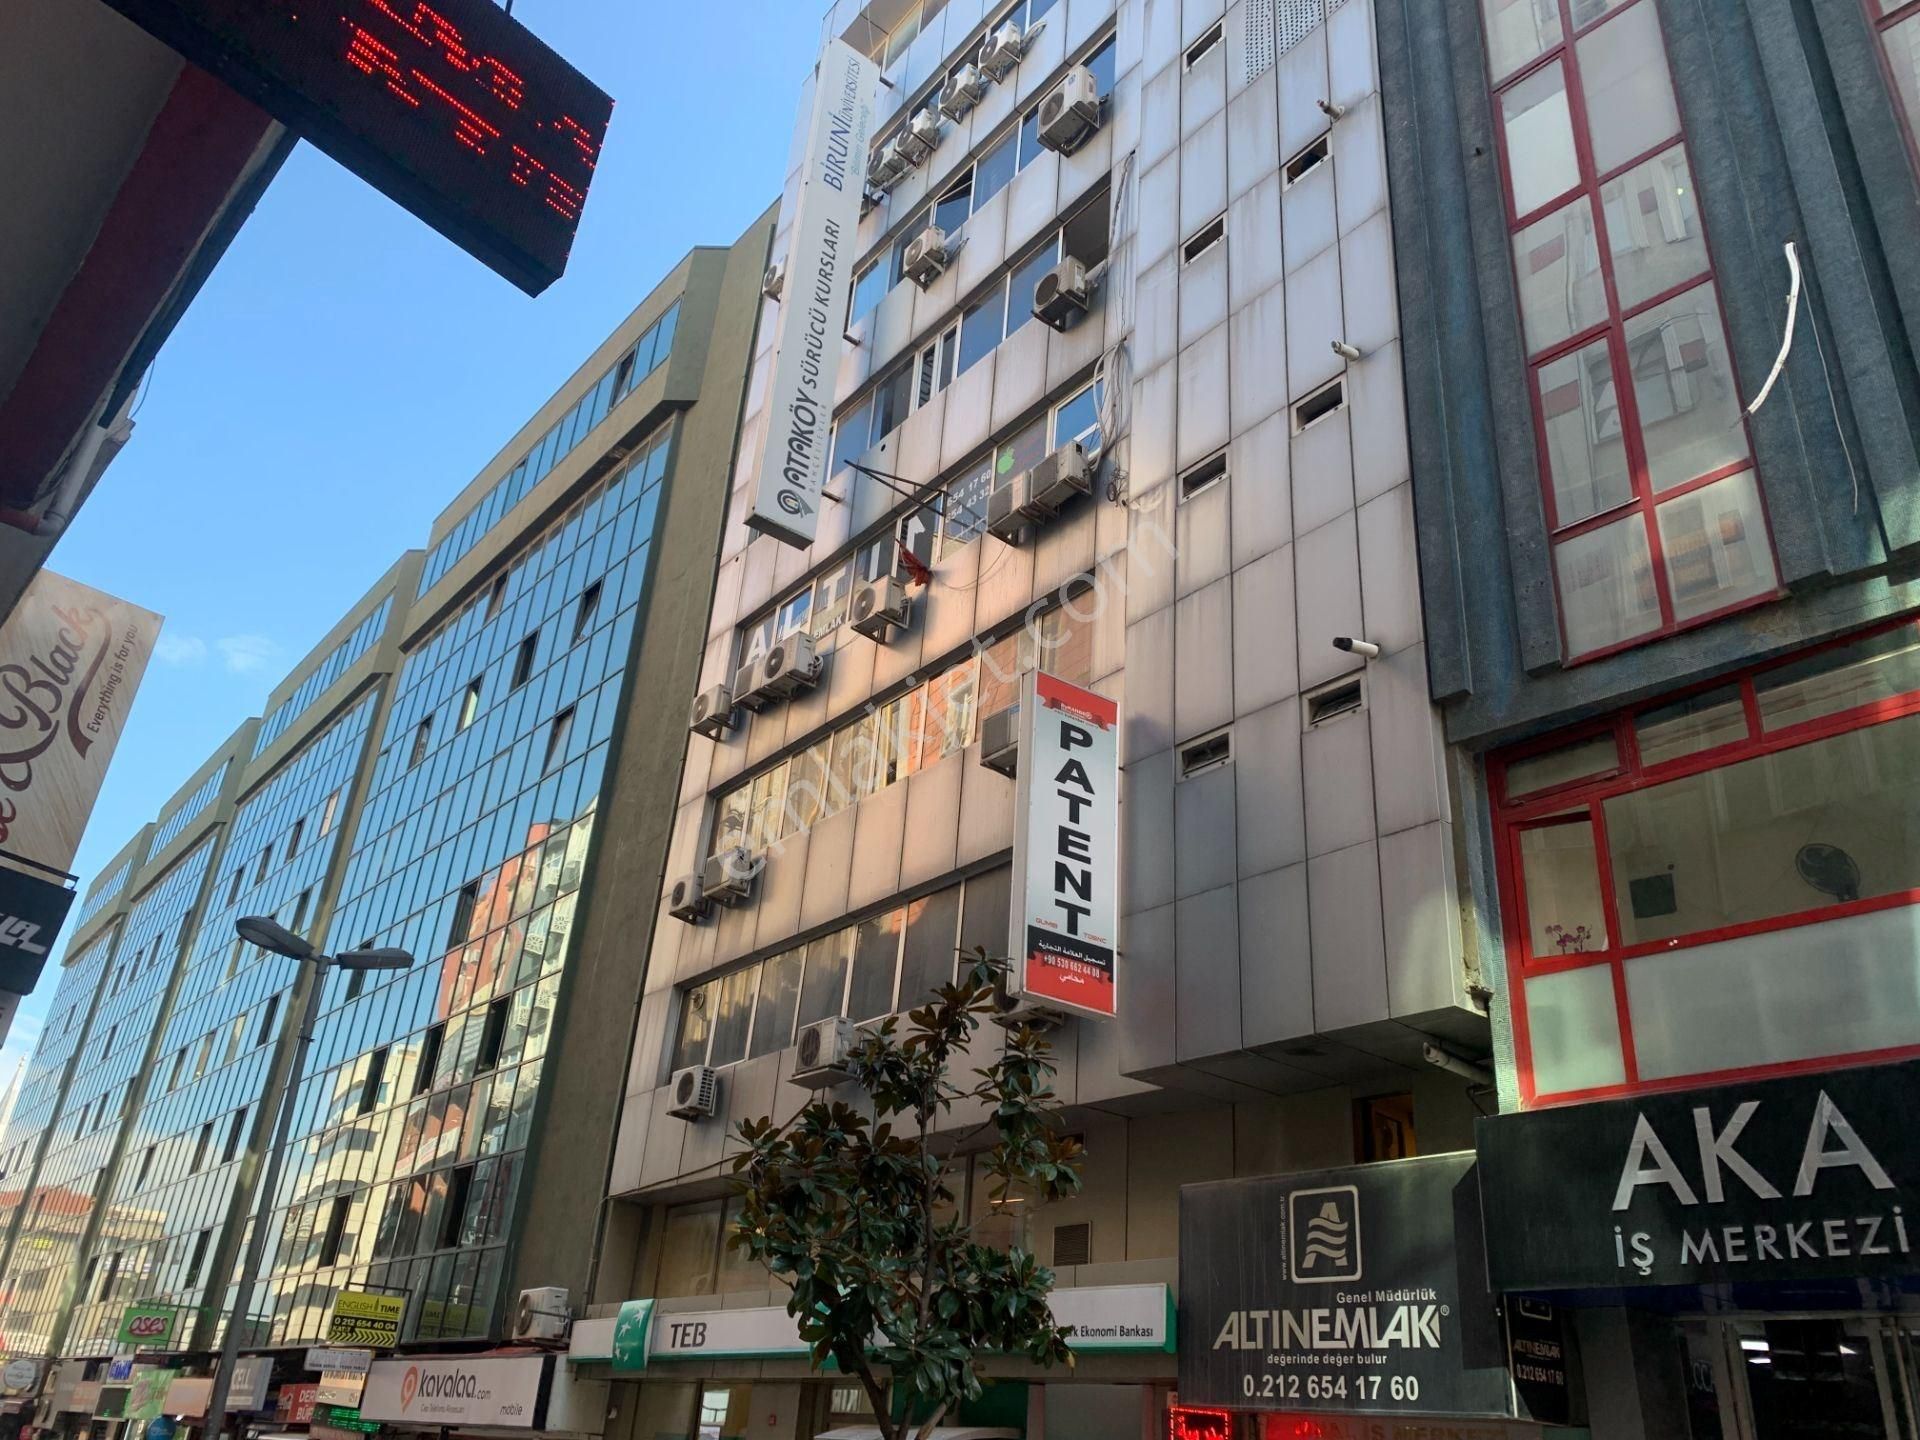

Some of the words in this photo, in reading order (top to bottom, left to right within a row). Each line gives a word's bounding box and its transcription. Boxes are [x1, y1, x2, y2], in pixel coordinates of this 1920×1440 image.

[824, 112, 851, 192] BİRUNİ
[814, 217, 841, 306] KURSLARI
[798, 306, 828, 389] SÜRÜCÜ
[783, 387, 818, 490] ATAKÖY
[124, 623, 138, 646] you
[116, 643, 132, 662] for
[114, 661, 125, 675] is
[87, 671, 122, 734] Everything
[1054, 720, 1096, 936] PATENT
[1611, 1089, 1896, 1211] AKA
[1614, 1226, 1655, 1275] İŞ
[1680, 1206, 1910, 1265] MERKEZİ
[338, 1299, 373, 1310] ENGLISH
[381, 1304, 401, 1313] TIME
[1336, 1290, 1372, 1304] Genel
[1375, 1288, 1437, 1302] Müdürlük
[670, 1322, 707, 1348] TEB
[1081, 1325, 1117, 1337] Ekonomi
[1120, 1325, 1154, 1337] Bankası
[1212, 1304, 1441, 1351] ALTINEMLAK
[1267, 1353, 1319, 1366] değerinde
[1322, 1353, 1354, 1366] değer
[1357, 1353, 1387, 1365] bulur
[1243, 1374, 1300, 1399] 0.212
[1307, 1375, 1348, 1399] 654
[1355, 1376, 1382, 1400] 17
[1390, 1376, 1419, 1401] 60
[500, 1403, 522, 1415] mobile
